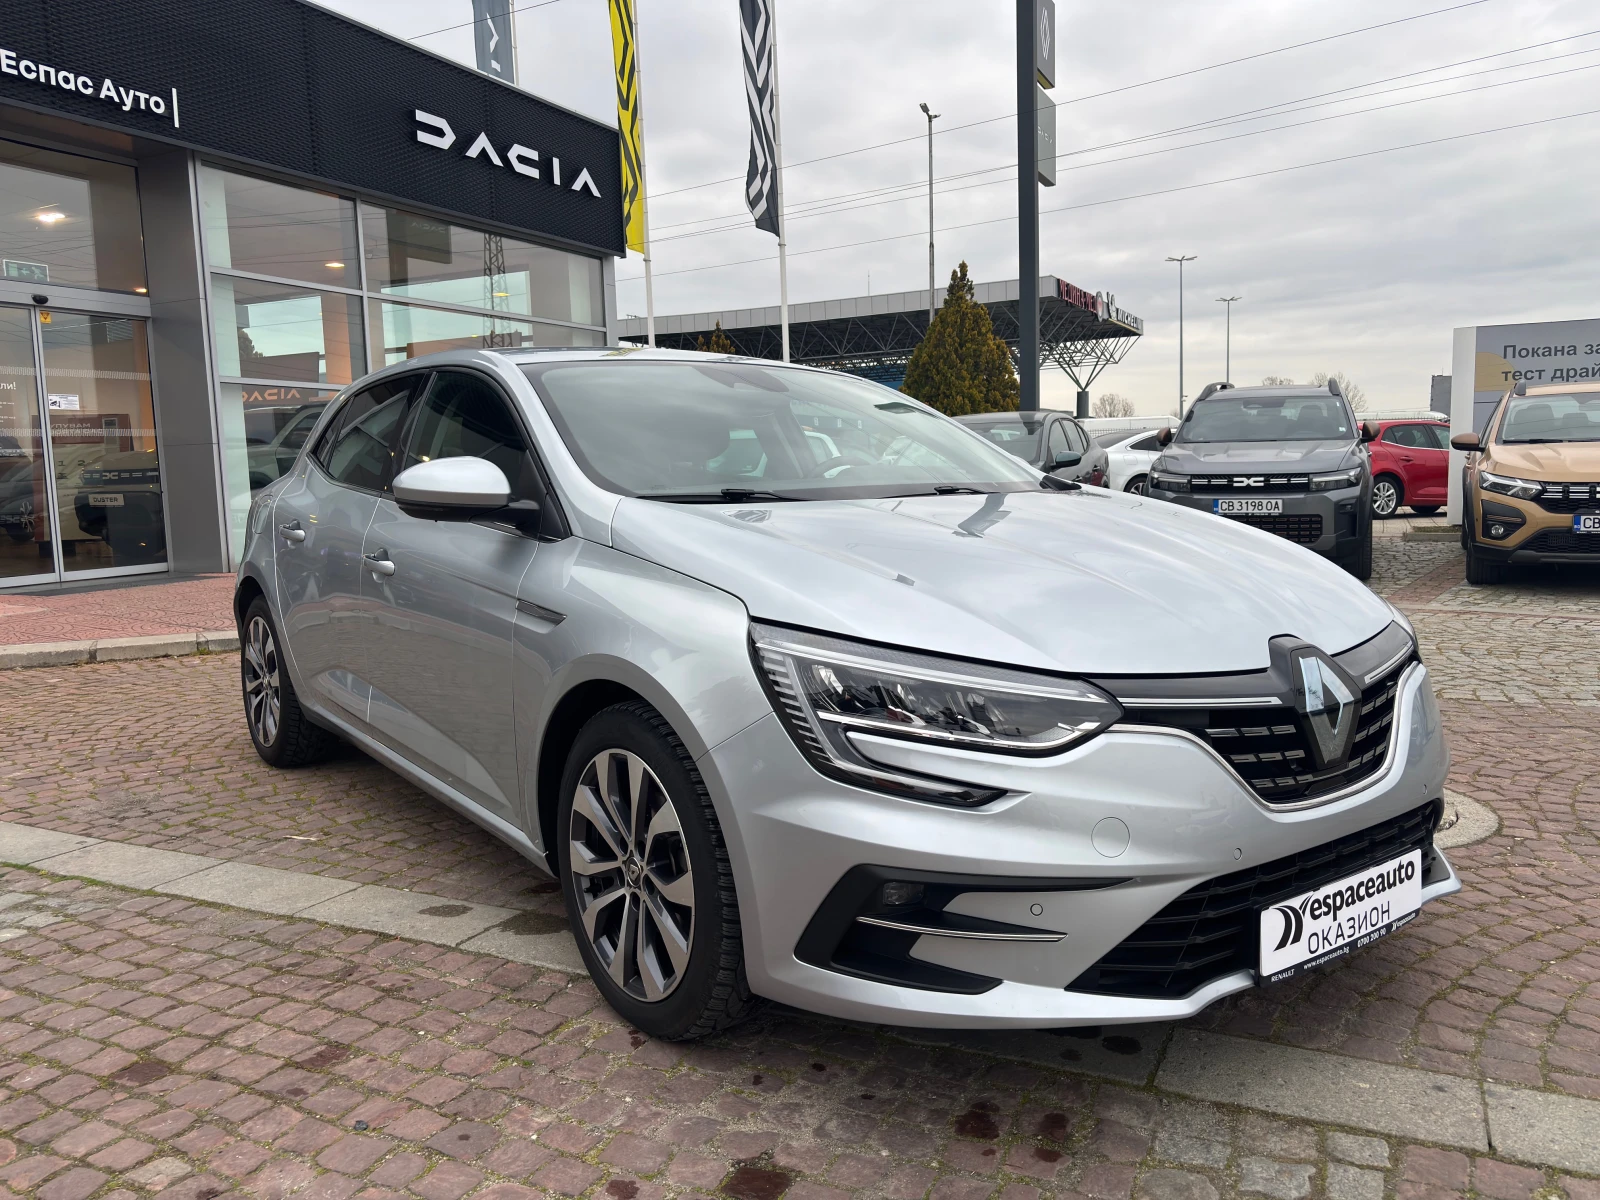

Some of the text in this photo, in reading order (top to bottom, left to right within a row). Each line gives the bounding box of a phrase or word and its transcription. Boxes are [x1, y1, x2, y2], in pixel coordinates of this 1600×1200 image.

[0, 48, 166, 112] Еспас Ауто
[415, 109, 602, 198] DACIA
[1501, 369, 1546, 381] тест
[1503, 344, 1577, 359] Покана
[1220, 500, 1235, 511] CB
[1237, 500, 1263, 511] 3198
[1309, 860, 1415, 922] espaceauto
[1308, 900, 1390, 955] ОКАЗИОН
[1271, 968, 1295, 982] RENAULT
[1303, 945, 1350, 970] www.espaceauto.bg
[1357, 933, 1370, 948] 0700
